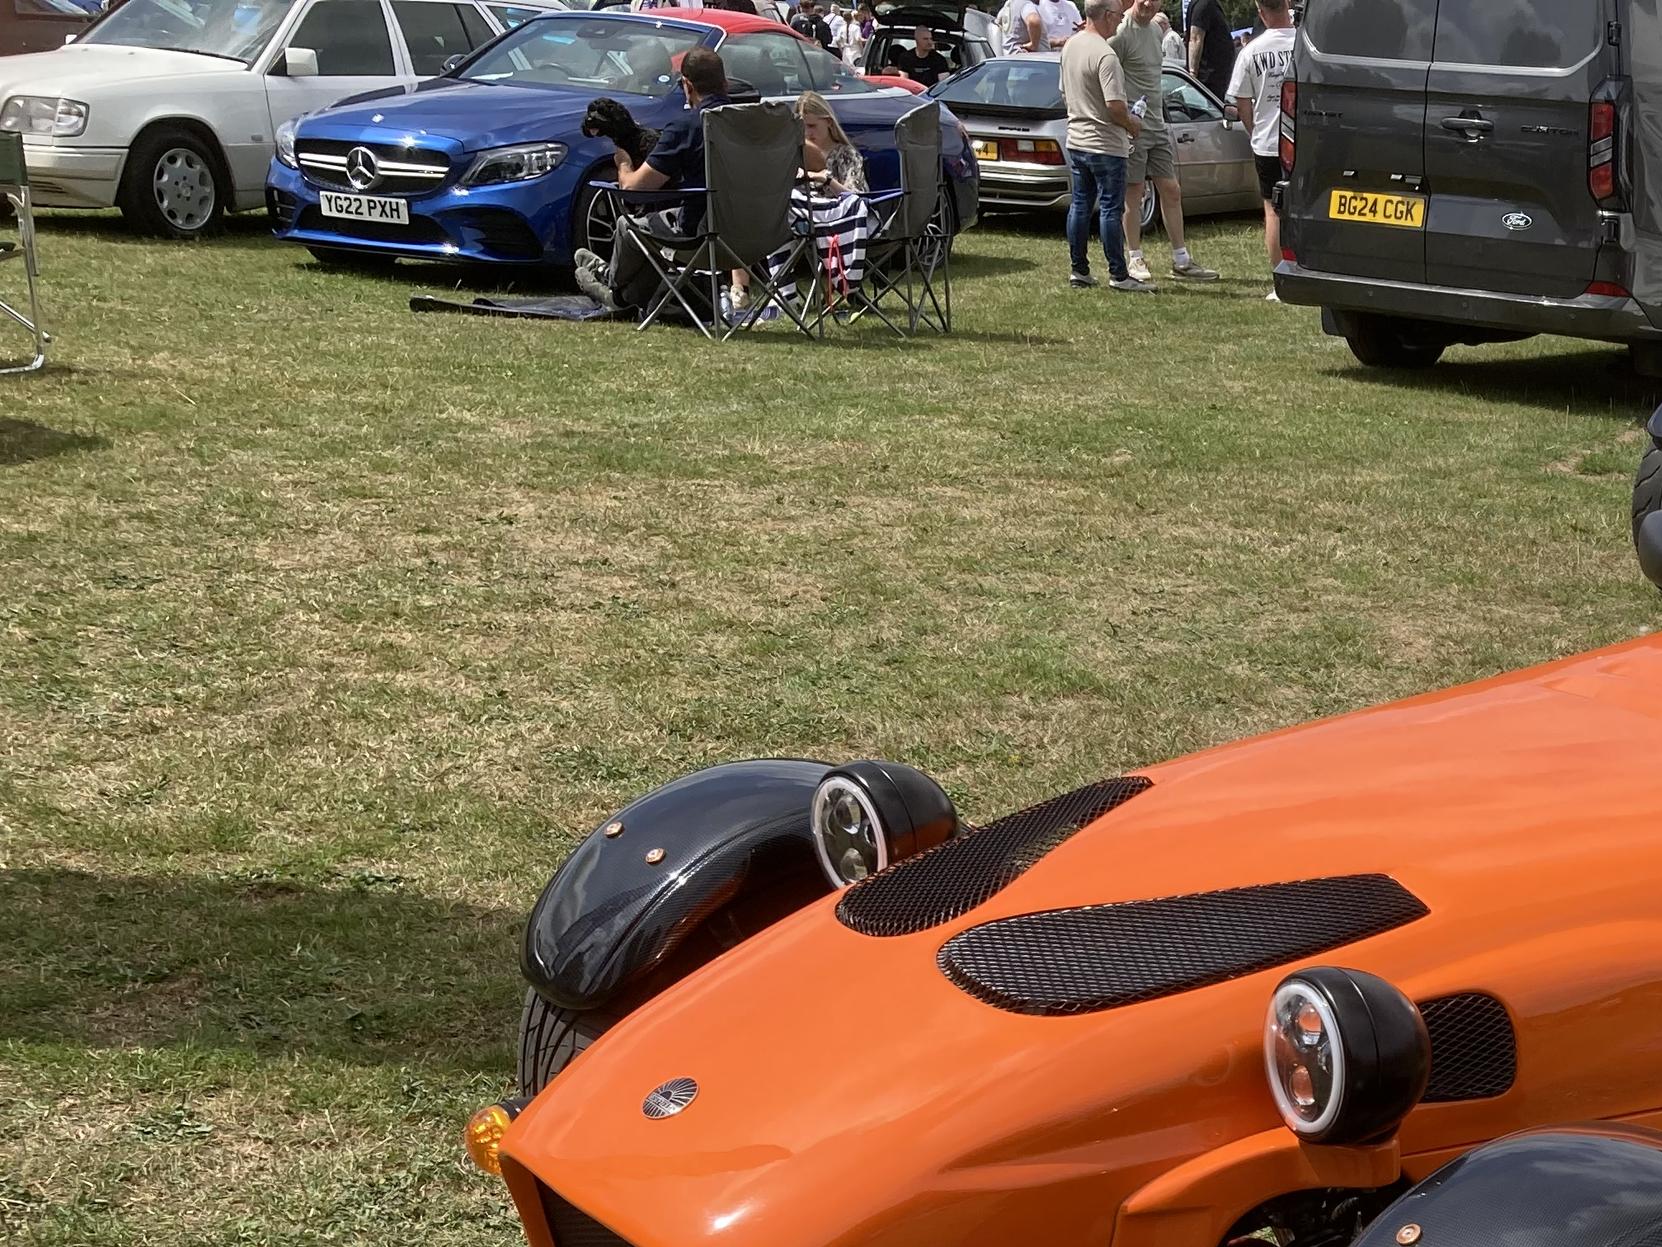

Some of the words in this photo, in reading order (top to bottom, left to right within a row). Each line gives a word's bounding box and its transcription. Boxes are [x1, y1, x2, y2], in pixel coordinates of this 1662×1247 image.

[325, 194, 364, 216] YG22
[366, 198, 402, 220] PXH
[1338, 194, 1378, 218] BG24
[1382, 199, 1415, 222] CGK
